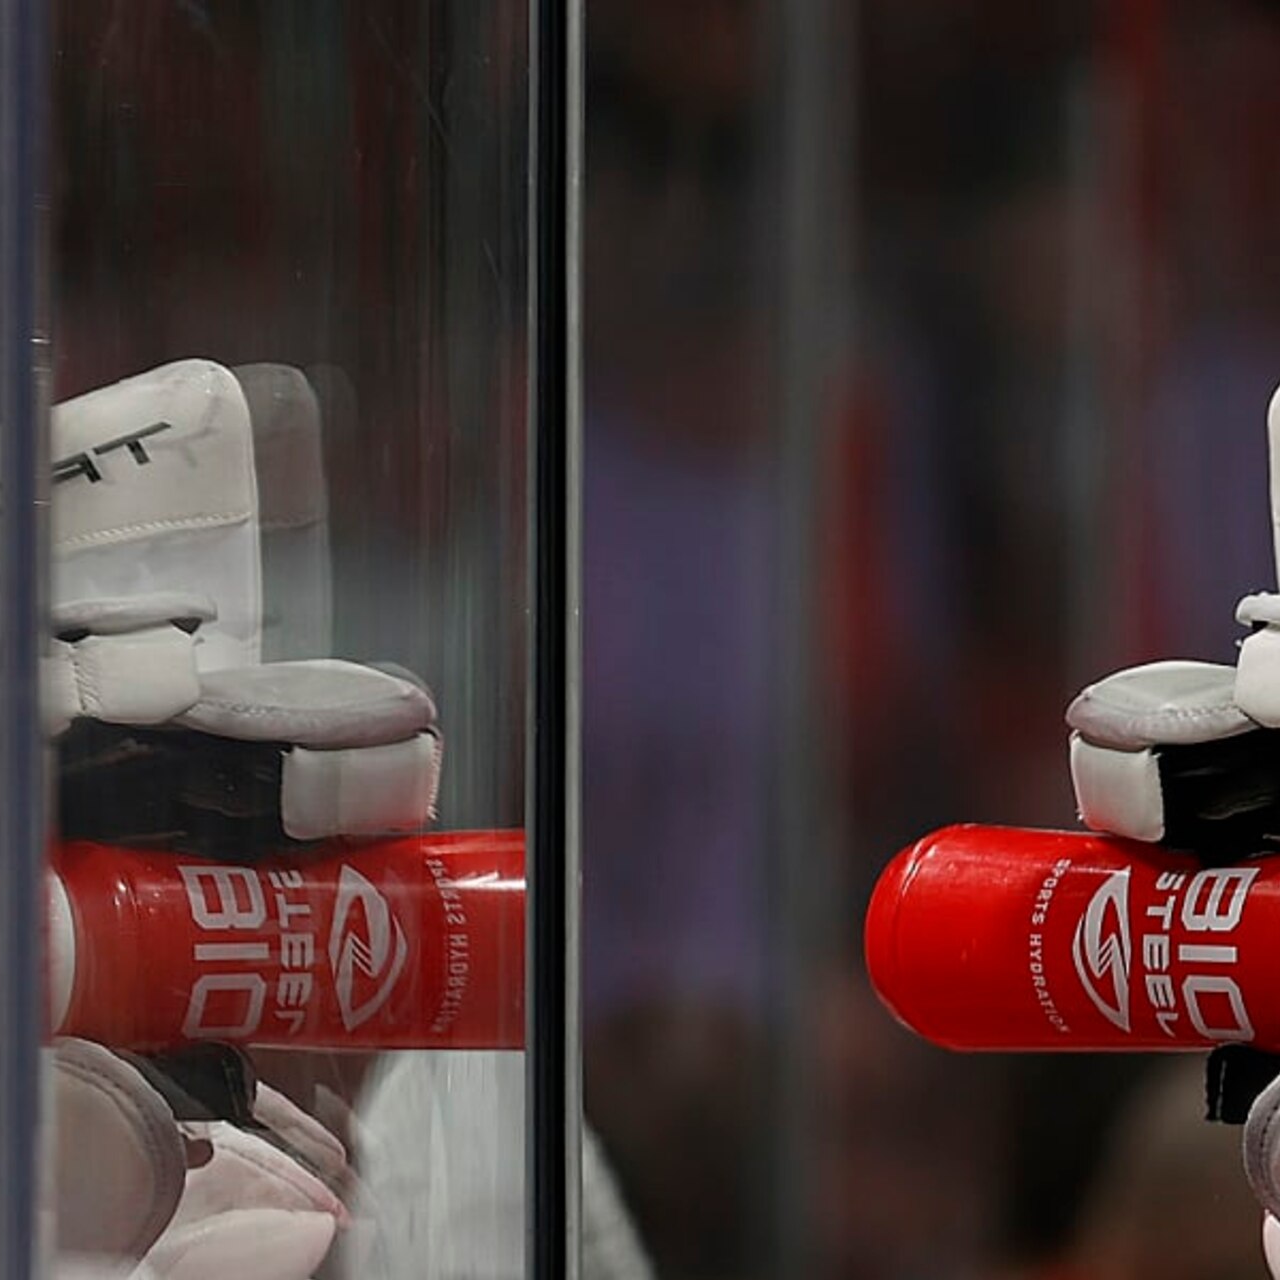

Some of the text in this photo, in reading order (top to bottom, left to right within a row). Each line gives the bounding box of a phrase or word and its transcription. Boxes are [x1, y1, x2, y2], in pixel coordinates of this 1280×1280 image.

[1029, 858, 1072, 1034] SPORTS HYDRATION
[1142, 871, 1186, 1038] STEEL
[1178, 867, 1261, 1042] BIO
